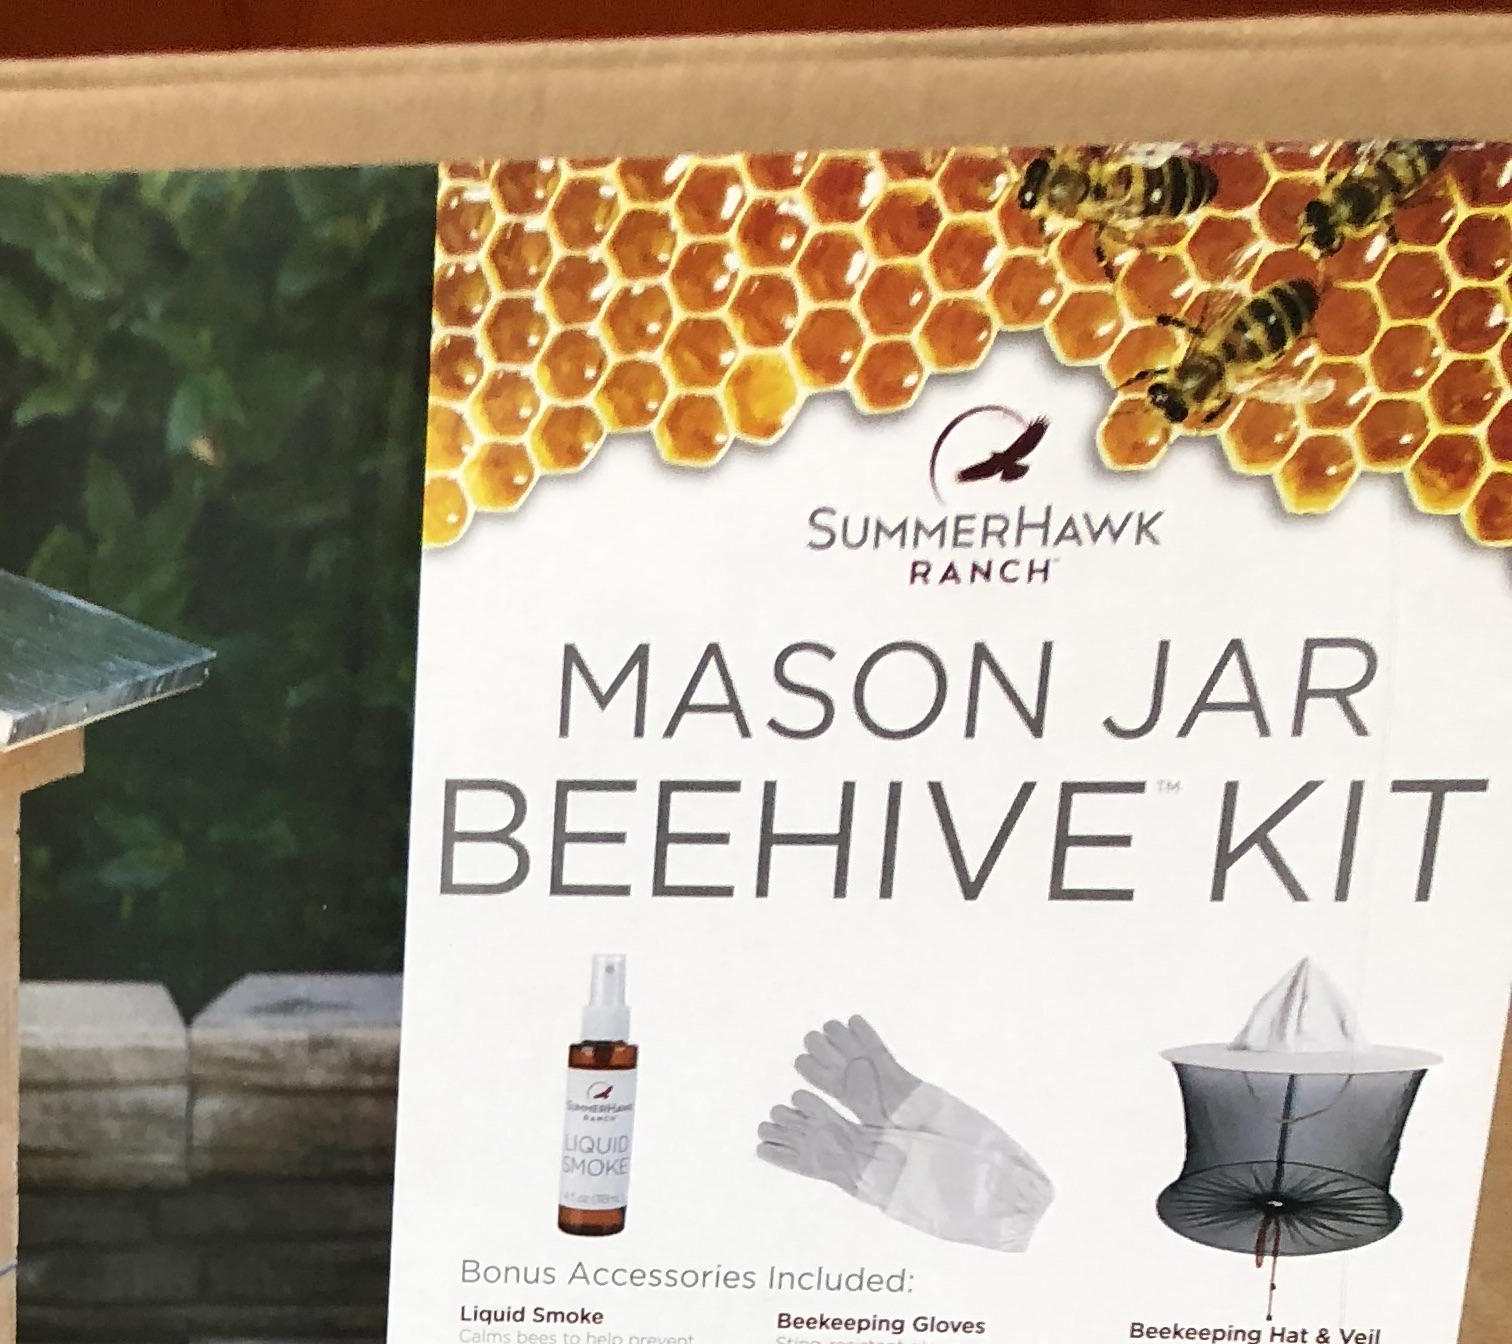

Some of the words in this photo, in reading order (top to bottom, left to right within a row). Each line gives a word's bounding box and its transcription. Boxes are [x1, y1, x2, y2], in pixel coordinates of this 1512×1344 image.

[910, 558, 1058, 585] RANCH
[559, 640, 1054, 741] MASON
[1103, 637, 1378, 740] JAR
[1210, 779, 1489, 902] KIT
[565, 1134, 629, 1154] LIQUID
[562, 1156, 631, 1176] SMOKE
[462, 1260, 555, 1285] Bonus
[568, 1262, 756, 1289] Accessories
[769, 1266, 914, 1293] Included:
[461, 1305, 525, 1325] Liquid
[533, 1307, 604, 1324] Smoke
[778, 1313, 905, 1335] Beekeeping
[913, 1316, 985, 1334] Gloves
[459, 1329, 511, 1344] Calms
[517, 1331, 557, 1344] bees
[563, 1333, 581, 1344] to
[1130, 1322, 1262, 1344] Beekeeping
[1270, 1326, 1309, 1344] Hat
[1315, 1328, 1330, 1344] &
